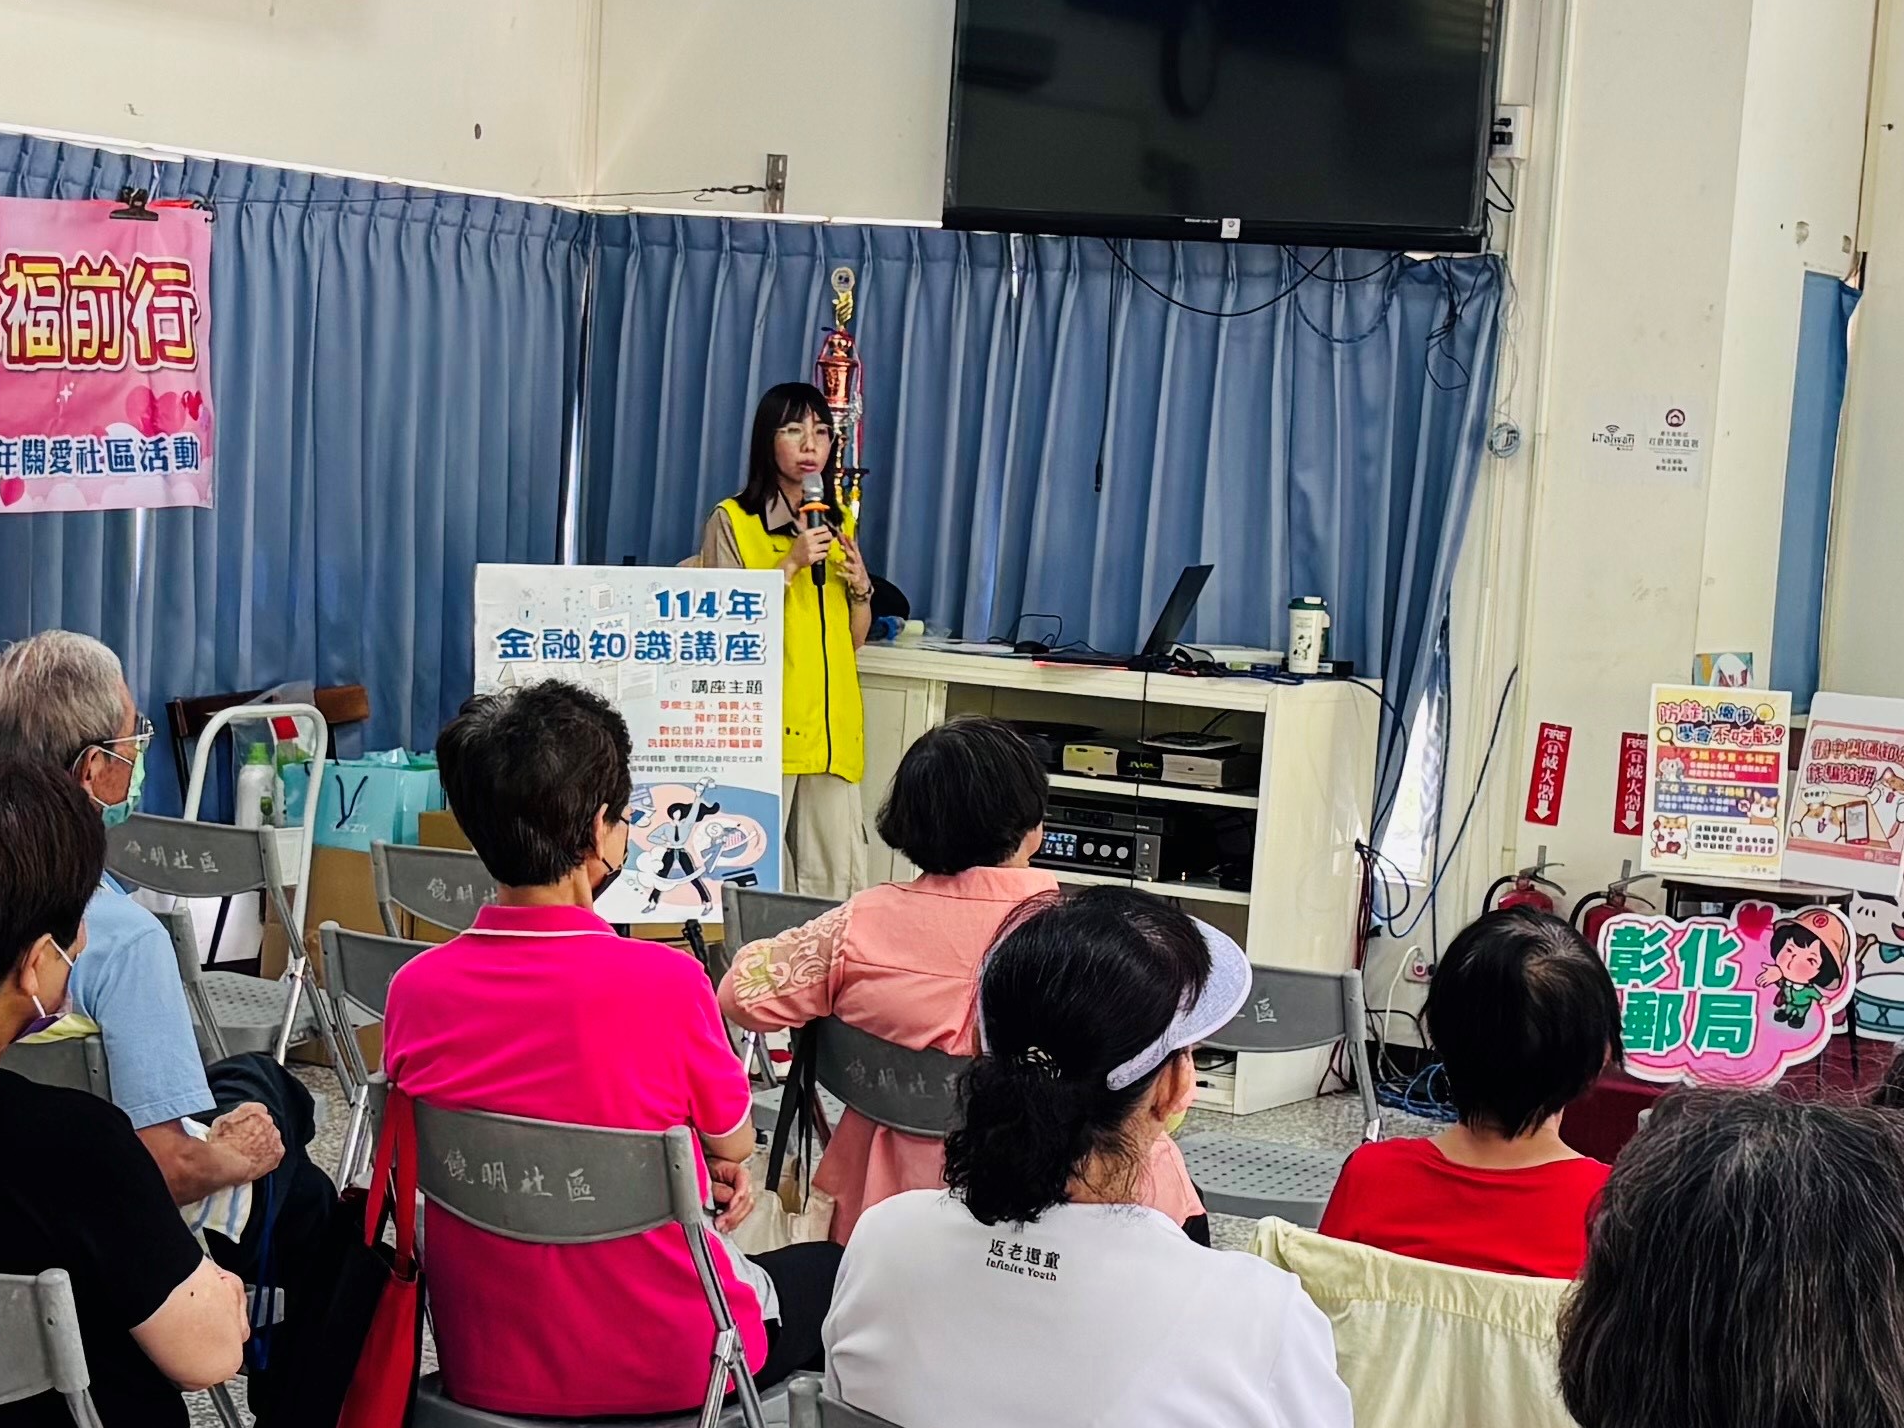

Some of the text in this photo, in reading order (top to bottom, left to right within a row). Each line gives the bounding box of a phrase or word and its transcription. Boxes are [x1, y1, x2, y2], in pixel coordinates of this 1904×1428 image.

[654, 588, 766, 622] 114年
[496, 627, 766, 665] 金融知識講座
[691, 679, 763, 694] 講座主題
[1544, 727, 1568, 741] FIRE
[1606, 925, 1743, 991] 彰化
[1620, 989, 1759, 1056] 郵局
[986, 1257, 1058, 1283] Infinite Youth
[988, 1238, 1062, 1271] 返老還童
